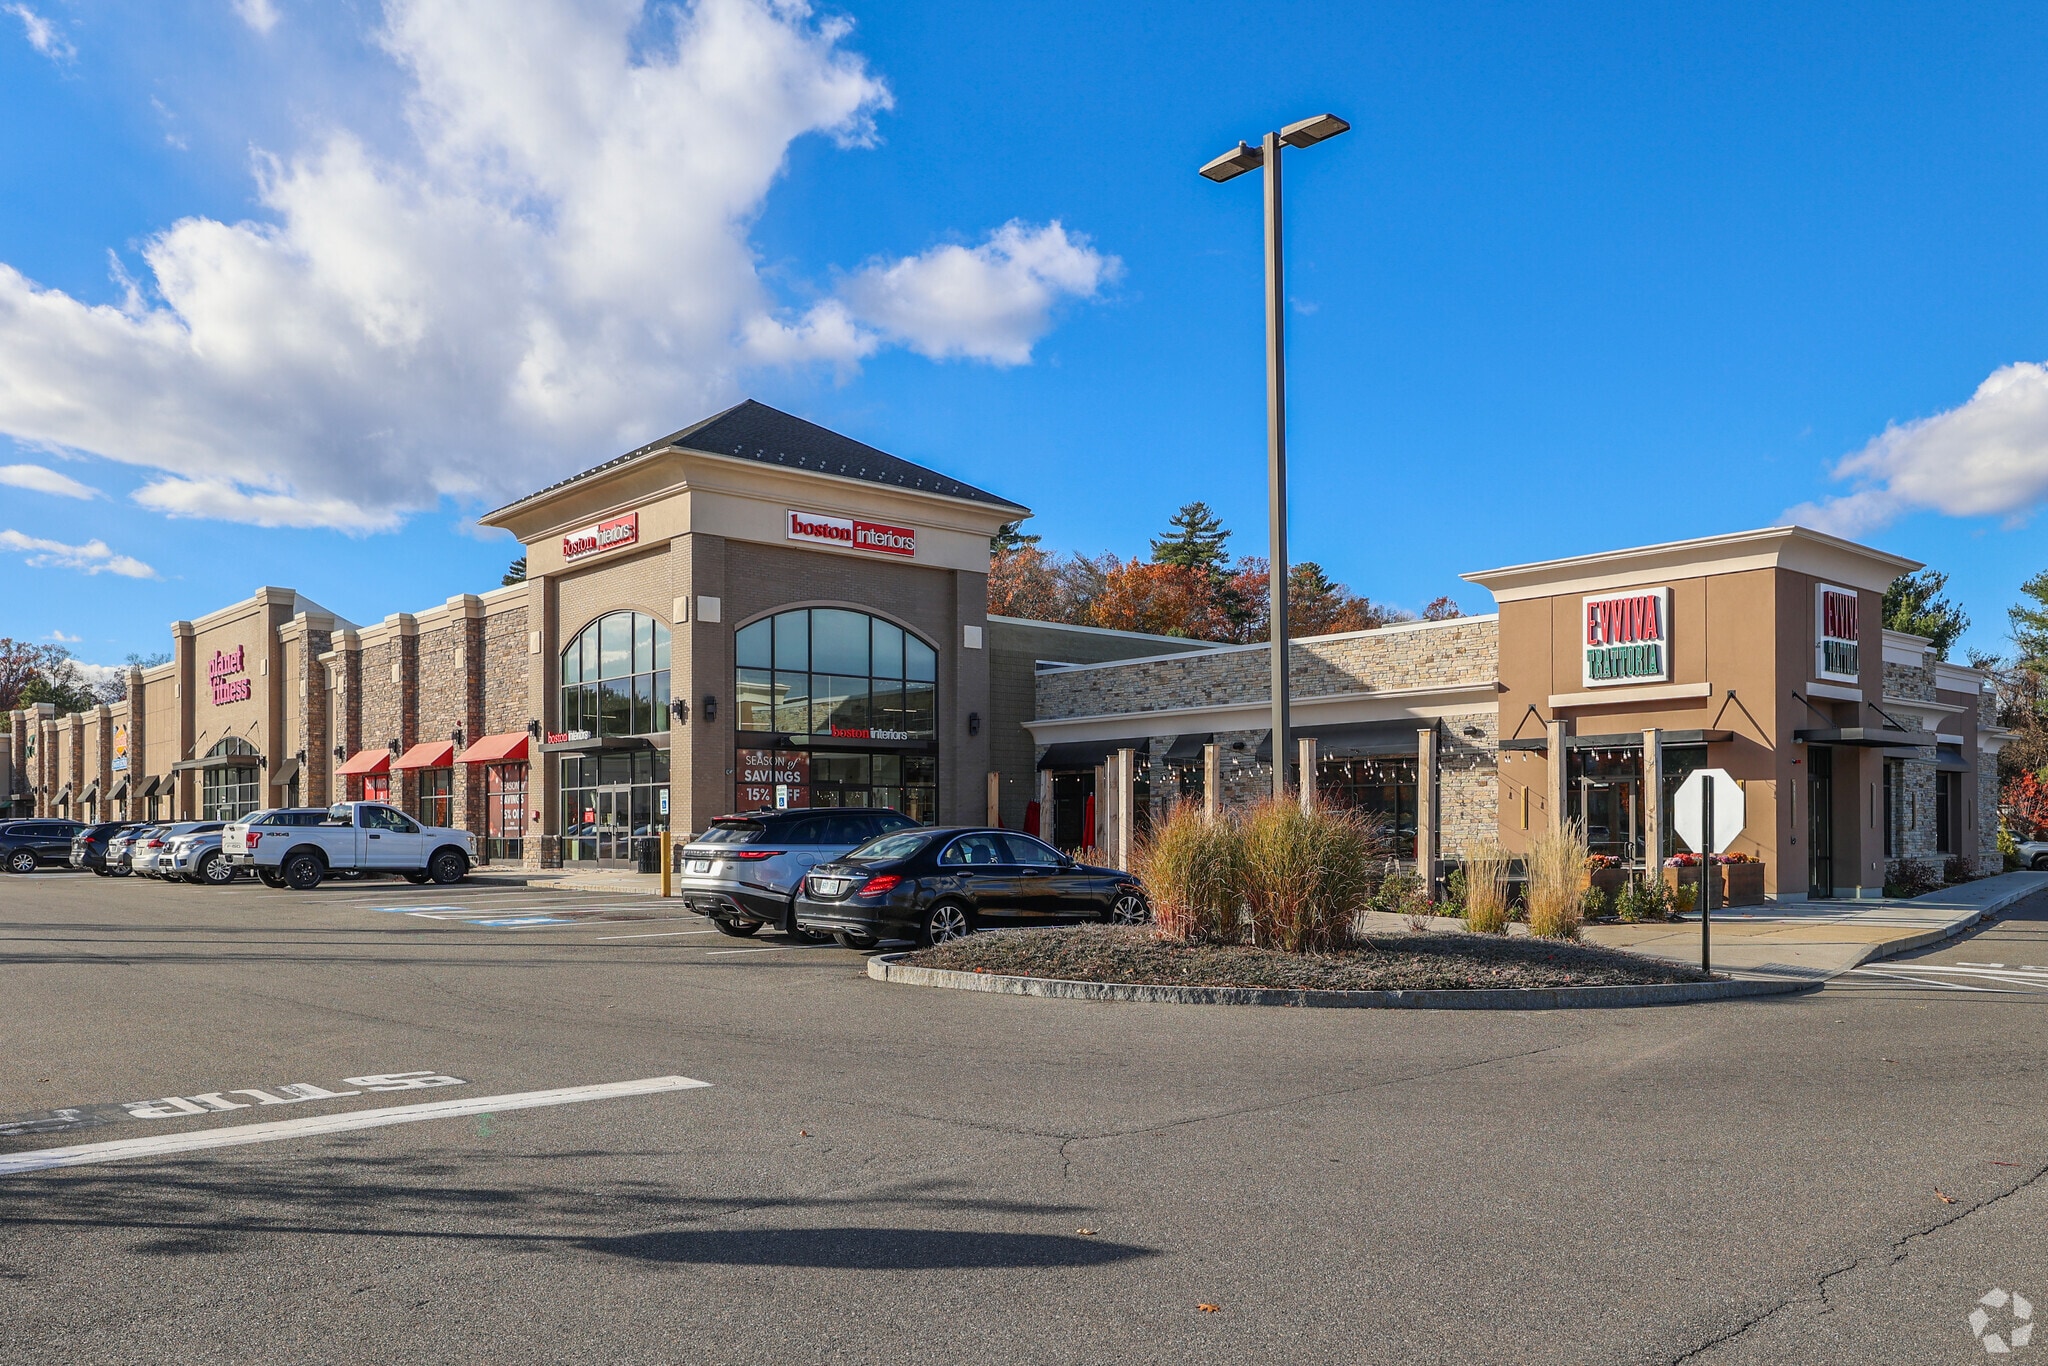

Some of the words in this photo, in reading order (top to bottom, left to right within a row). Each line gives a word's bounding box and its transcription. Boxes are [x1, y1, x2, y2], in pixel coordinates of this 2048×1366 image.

[562, 536, 597, 556] boston
[597, 524, 635, 547] interiors
[791, 514, 853, 541] boston
[856, 525, 915, 550] interiors
[1586, 595, 1658, 645] EVVIVA
[1826, 591, 1859, 640] EVVIVA
[208, 645, 243, 685] planet
[1586, 643, 1658, 679] TRATTORIA
[212, 677, 250, 705] fitness
[547, 731, 568, 744] boston
[831, 724, 870, 738] boston
[870, 727, 908, 740] interiors
[744, 769, 801, 783] SAVINGS
[745, 755, 785, 766] SEASON
[787, 757, 801, 770] of
[746, 788, 770, 801] 15%
